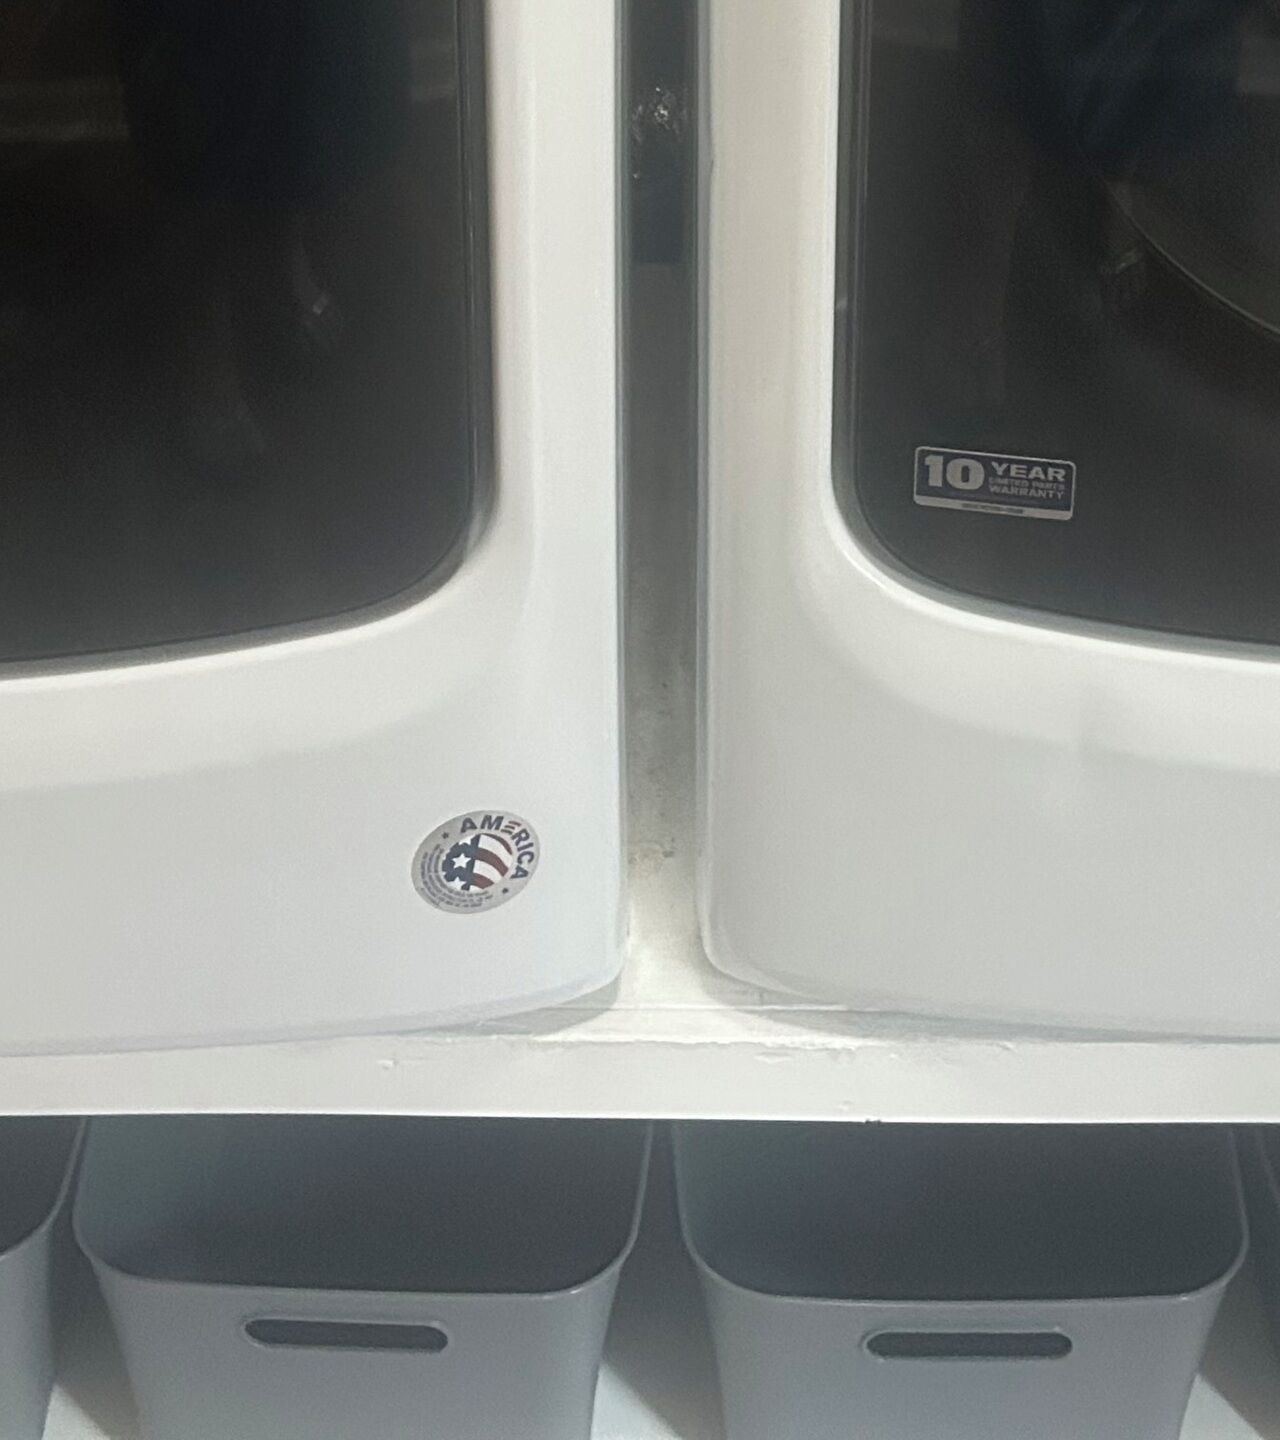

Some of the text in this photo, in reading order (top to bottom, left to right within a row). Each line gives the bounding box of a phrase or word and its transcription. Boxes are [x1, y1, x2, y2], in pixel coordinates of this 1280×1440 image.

[925, 455, 1065, 490] 10 YEAR
[989, 485, 1063, 499] WARRANTY
[461, 815, 534, 879] AMERICA
